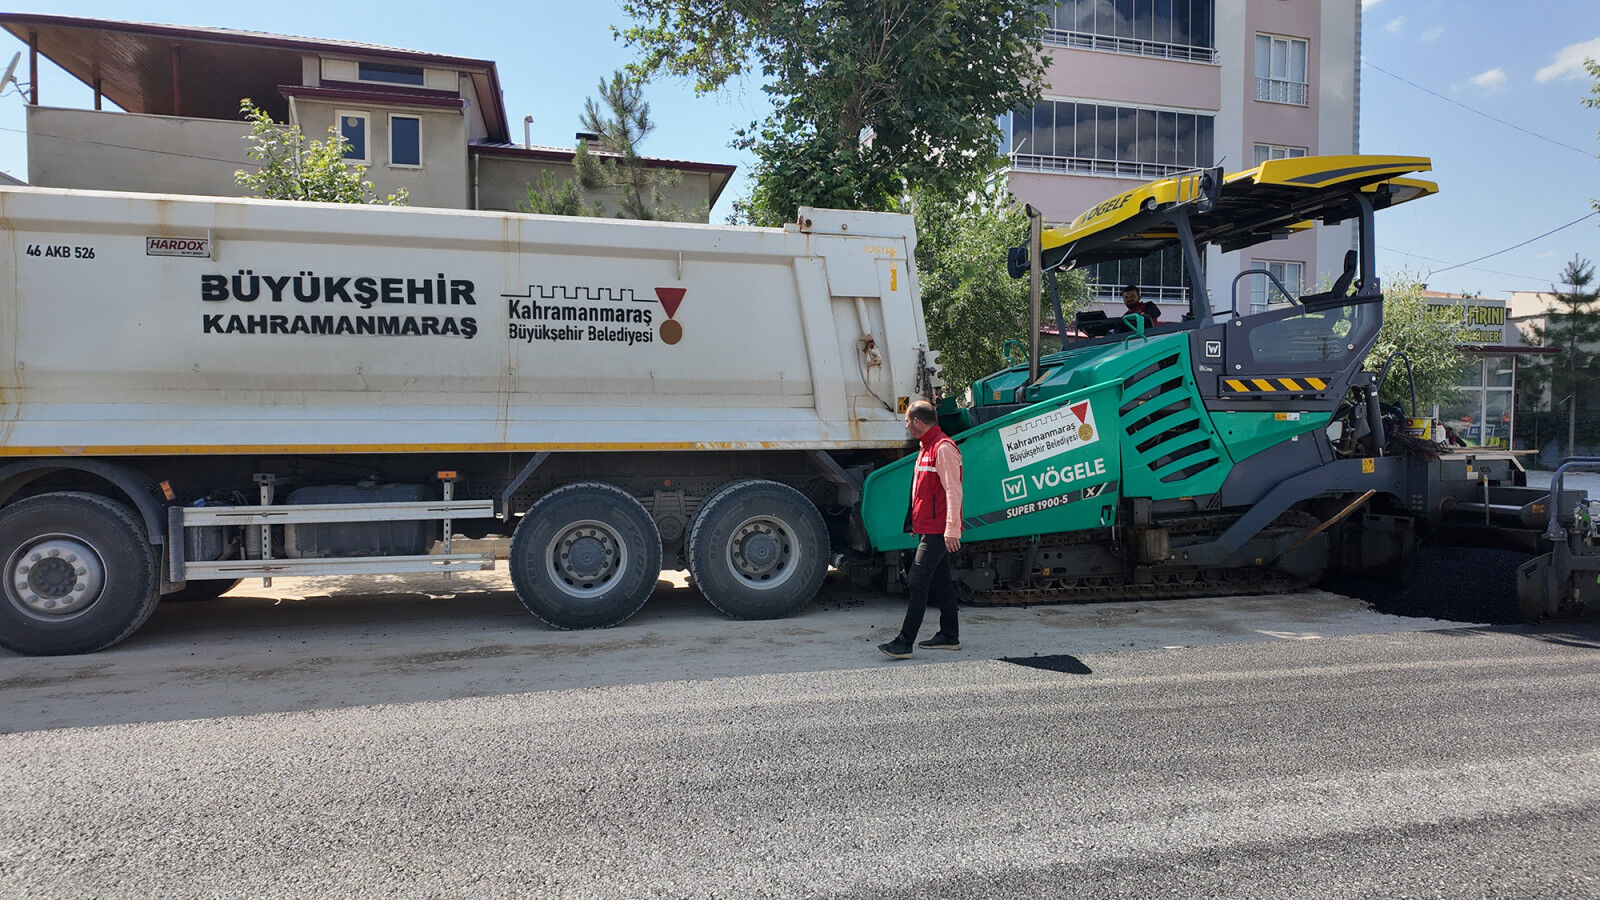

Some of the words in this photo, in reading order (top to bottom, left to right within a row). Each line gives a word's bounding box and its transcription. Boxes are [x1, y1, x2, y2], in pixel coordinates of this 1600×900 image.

[26, 244, 41, 257] 46
[45, 245, 71, 258] AKB
[74, 247, 95, 259] 526
[150, 239, 203, 250] HARDOX
[201, 269, 477, 309] BÜYÜKŞEHİR
[508, 299, 652, 326] Kahramanmaraş
[203, 314, 478, 339] KAHRAMANMARAŞ
[509, 323, 584, 344] Büyükşehir
[588, 325, 653, 346] Belediyesi
[1006, 422, 1076, 452] Kahramanmaraş
[1009, 444, 1045, 463] Büyükşehir
[1046, 432, 1079, 451] Belediyesi
[1031, 457, 1106, 490] VÖGELE
[1006, 503, 1035, 519] SUPER
[1037, 494, 1069, 510] 1900-5
